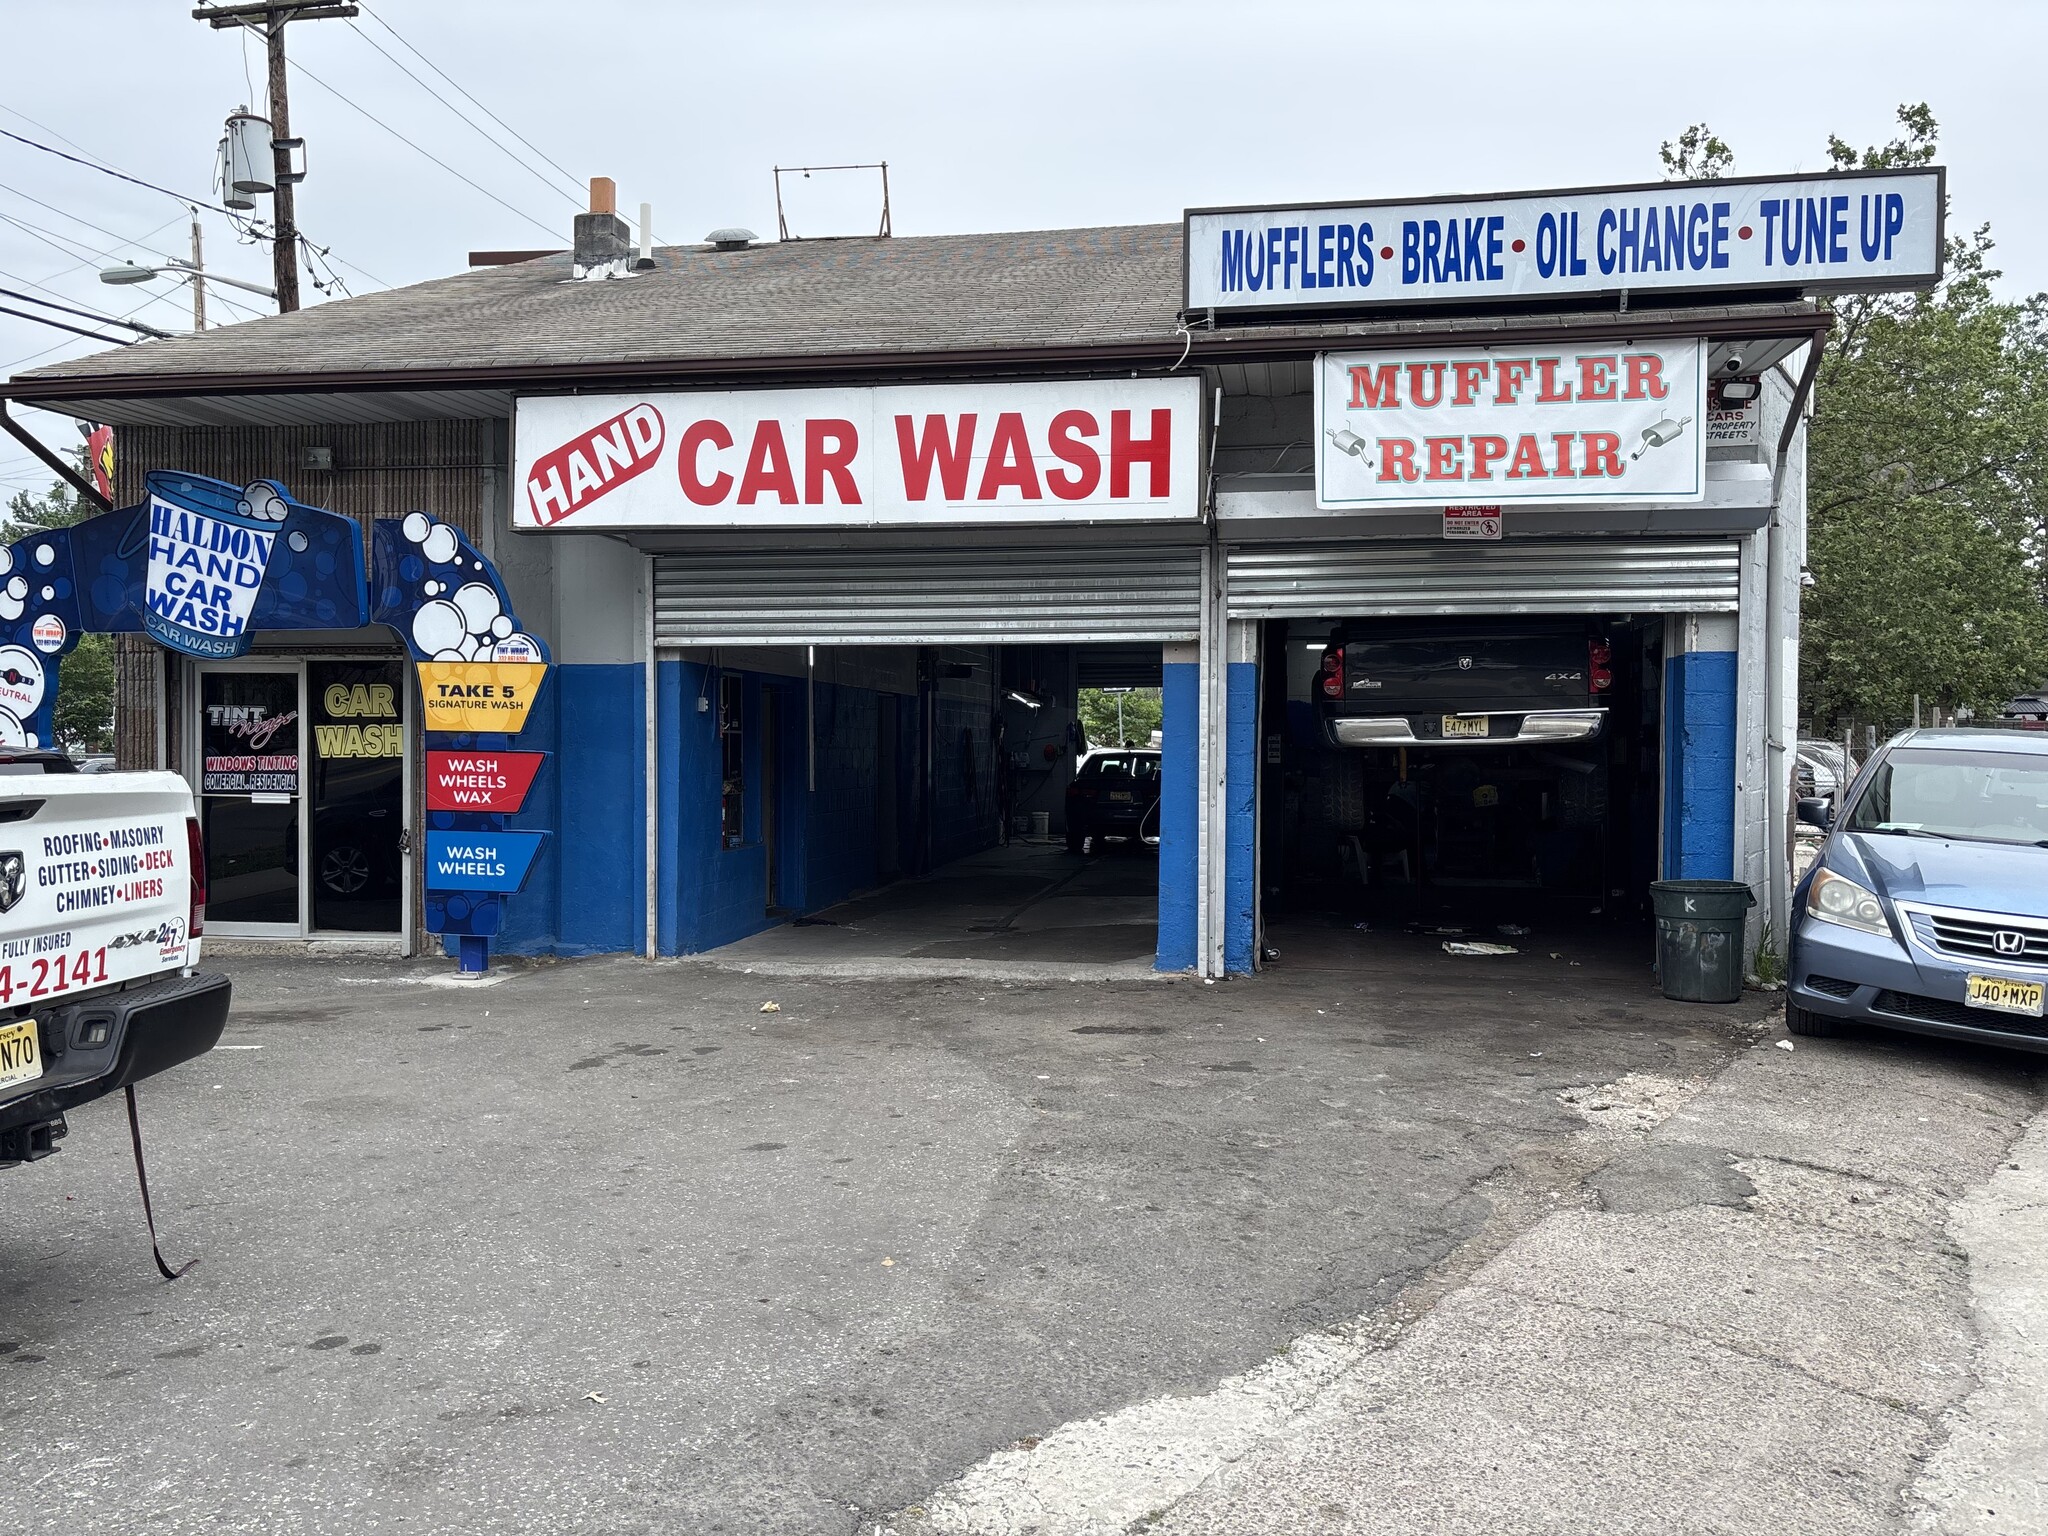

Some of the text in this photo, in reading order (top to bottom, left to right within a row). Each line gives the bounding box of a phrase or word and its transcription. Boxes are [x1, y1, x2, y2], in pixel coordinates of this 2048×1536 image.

[1221, 193, 1904, 292] MUFFLERS BRAKE OIL CHANGE TUNE UP
[1346, 352, 1670, 411] MUFFLER
[1711, 421, 1756, 430] PROPERTY
[528, 404, 1172, 526] HAND CAR WASH
[1375, 430, 1627, 484] REPAIR
[150, 504, 272, 567] HALDON
[149, 537, 261, 589] HAND
[165, 572, 233, 612] CAR
[149, 588, 244, 636] WASH
[146, 615, 238, 655] CAR WASH
[324, 683, 397, 718] CAR
[428, 700, 523, 710] SIGNATURE WASH
[438, 685, 514, 698] TAKE 5
[206, 705, 267, 726] TINT
[314, 724, 403, 759] WASH
[206, 755, 298, 771] WINDOWS TINTING
[447, 759, 497, 772] WASH
[439, 774, 507, 789] WHEELS
[453, 791, 492, 804] WAX
[43, 826, 164, 857] ROOFING MASONRY
[447, 846, 497, 860] WASH
[38, 849, 174, 887] GUTTER SIDING DECK
[437, 862, 506, 876] WHEELS
[56, 878, 163, 913] CHIMNEY LINERS
[1684, 896, 1697, 912] K
[2, 932, 72, 959] FULLY INSURED
[160, 945, 186, 955] Emergency
[161, 955, 179, 963] Services
[1972, 983, 2000, 1002] J40
[2010, 988, 2039, 1007] MXP
